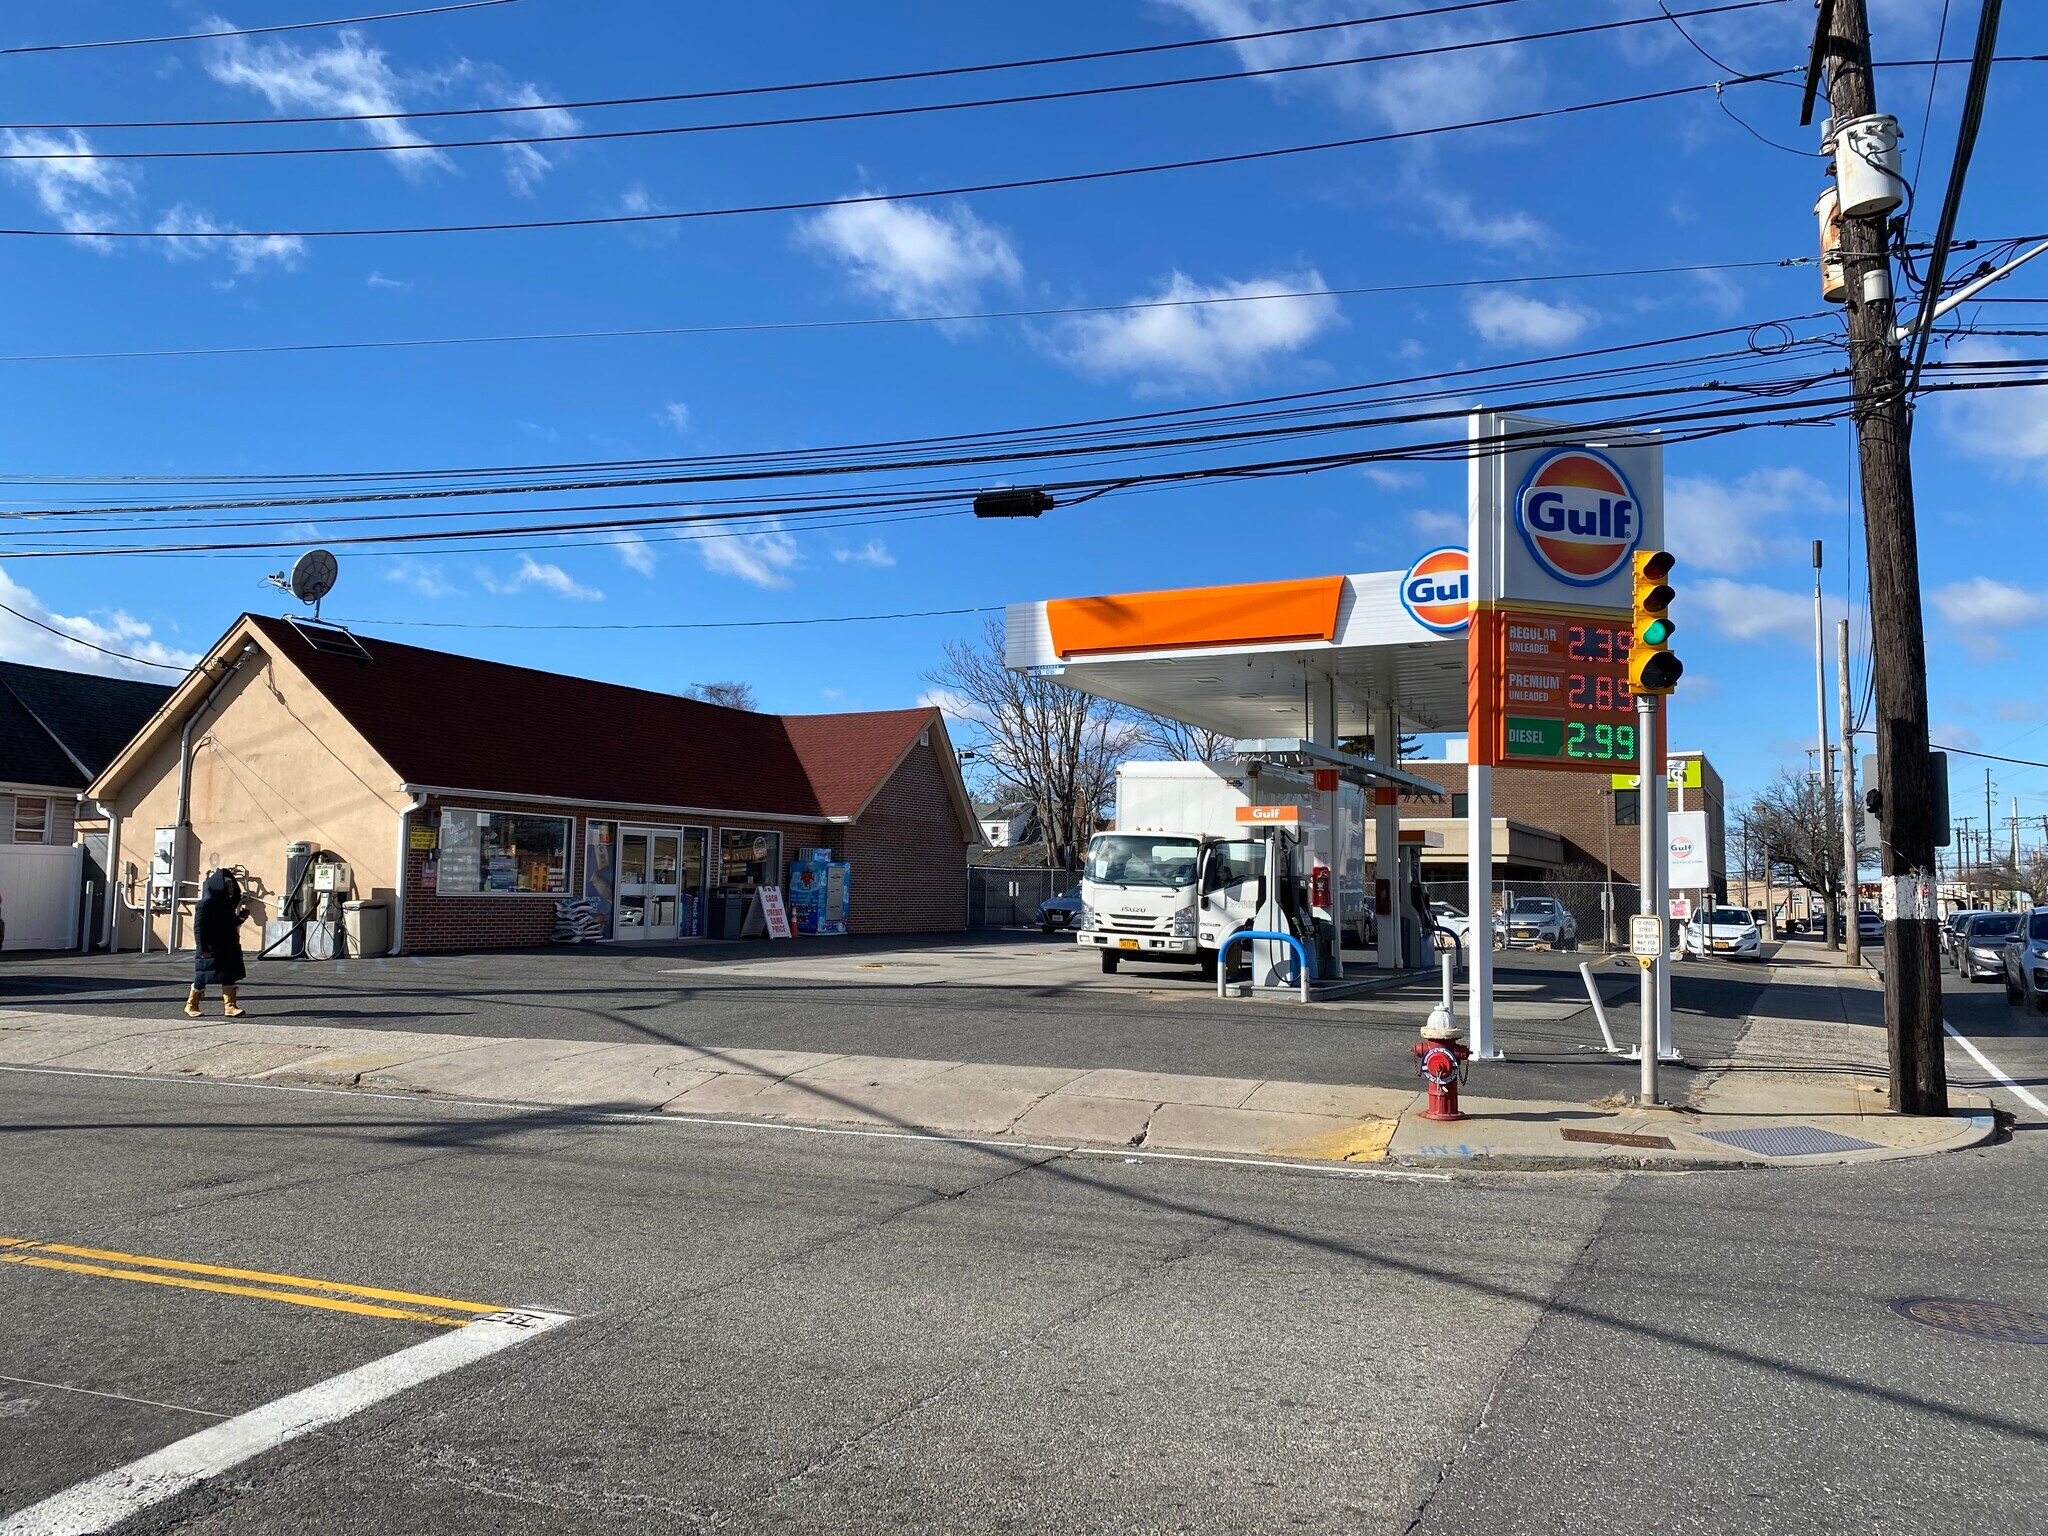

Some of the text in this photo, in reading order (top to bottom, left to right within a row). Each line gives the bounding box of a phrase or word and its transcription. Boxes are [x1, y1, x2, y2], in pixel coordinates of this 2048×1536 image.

[1528, 491, 1632, 539] Gulf
[1407, 574, 1468, 603] Gul
[1509, 625, 1634, 664] REGULAR 2.39
[1509, 642, 1549, 654] UNLEADED
[1509, 673, 1560, 689] PREMIUM
[1509, 690, 1549, 702] UNLEADED
[1509, 722, 1634, 760] DIESEL 2.99
[1252, 808, 1280, 819] Gulf
[765, 894, 778, 903] CASH
[766, 908, 783, 917] CREDIT
[770, 916, 784, 925] SAME
[771, 925, 786, 933] PRICE
